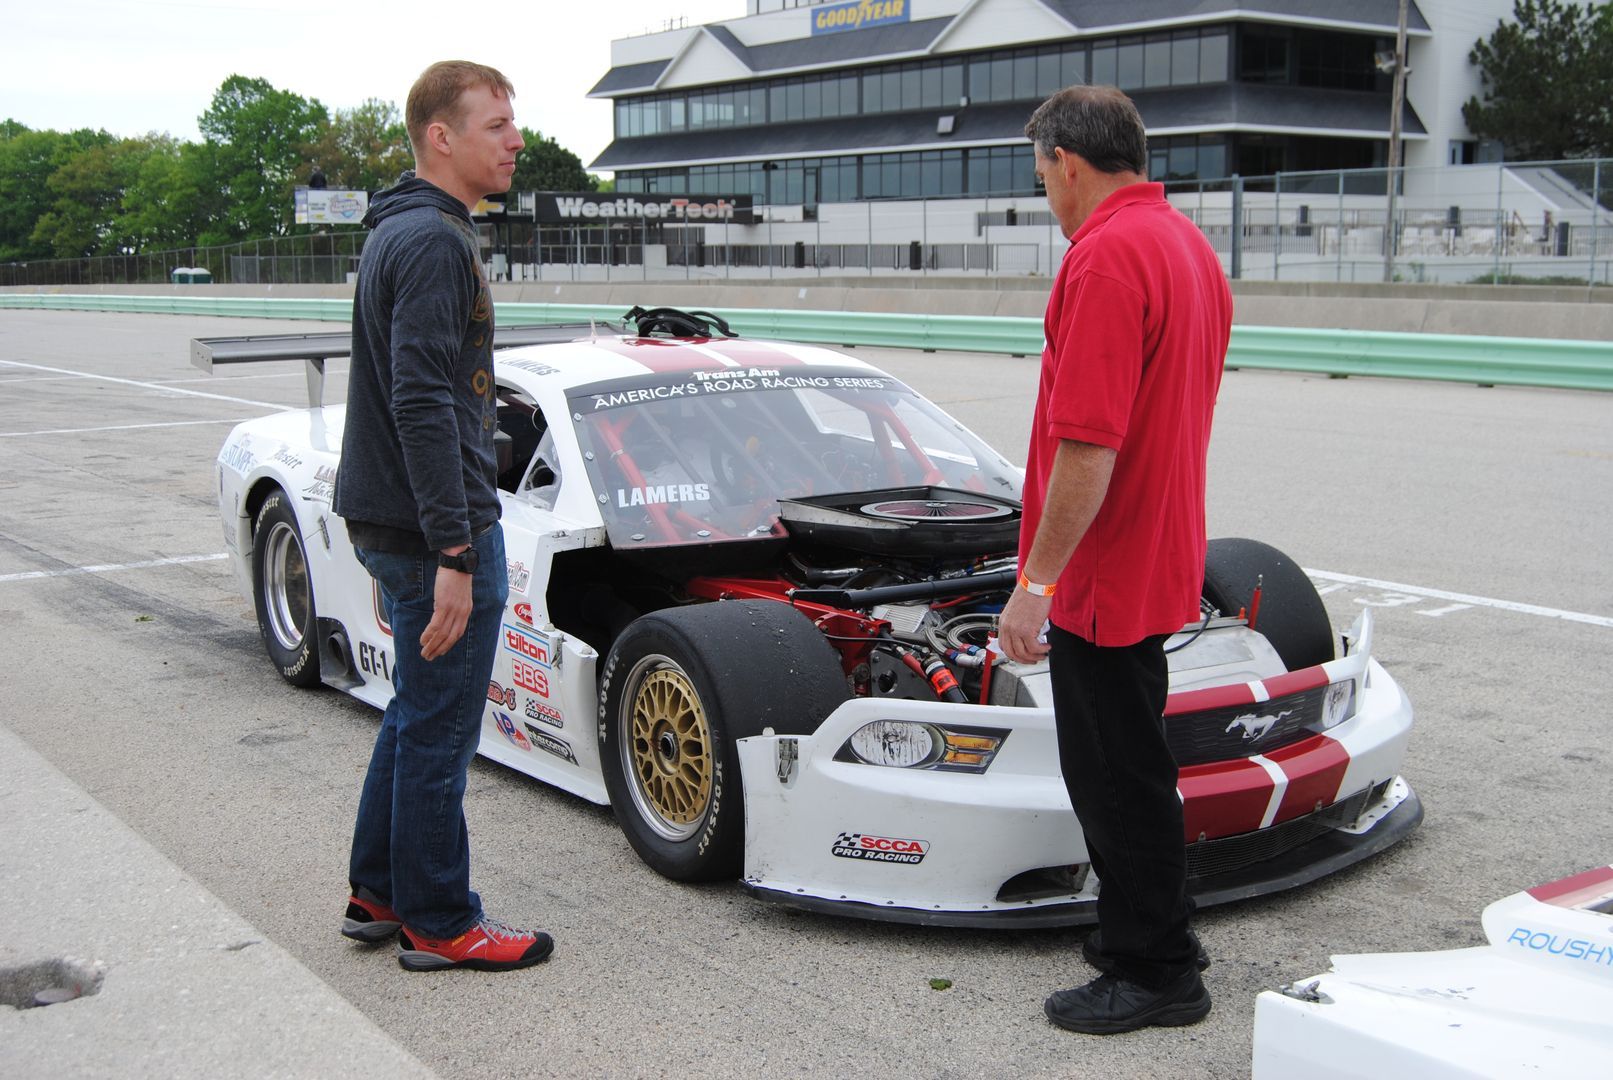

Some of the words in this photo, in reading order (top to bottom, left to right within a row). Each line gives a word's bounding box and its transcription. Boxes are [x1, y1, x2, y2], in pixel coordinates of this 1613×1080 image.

[555, 196, 734, 218] WeatherTech
[692, 370, 747, 381] Trans
[748, 367, 780, 378] Am
[594, 382, 698, 409] AMERICA'S
[703, 379, 757, 393] ROAD
[763, 377, 829, 388] RACING
[835, 377, 884, 389] SERIES
[617, 483, 710, 508] LAMERS
[506, 630, 548, 664] tilton
[359, 641, 390, 681] GT-1
[512, 658, 549, 699] BBS
[526, 709, 539, 719] PRO
[540, 714, 563, 728] RACING
[535, 703, 562, 721] SCCA
[833, 847, 863, 857] PRO
[864, 851, 921, 863] RACING
[860, 837, 924, 853] SCCA
